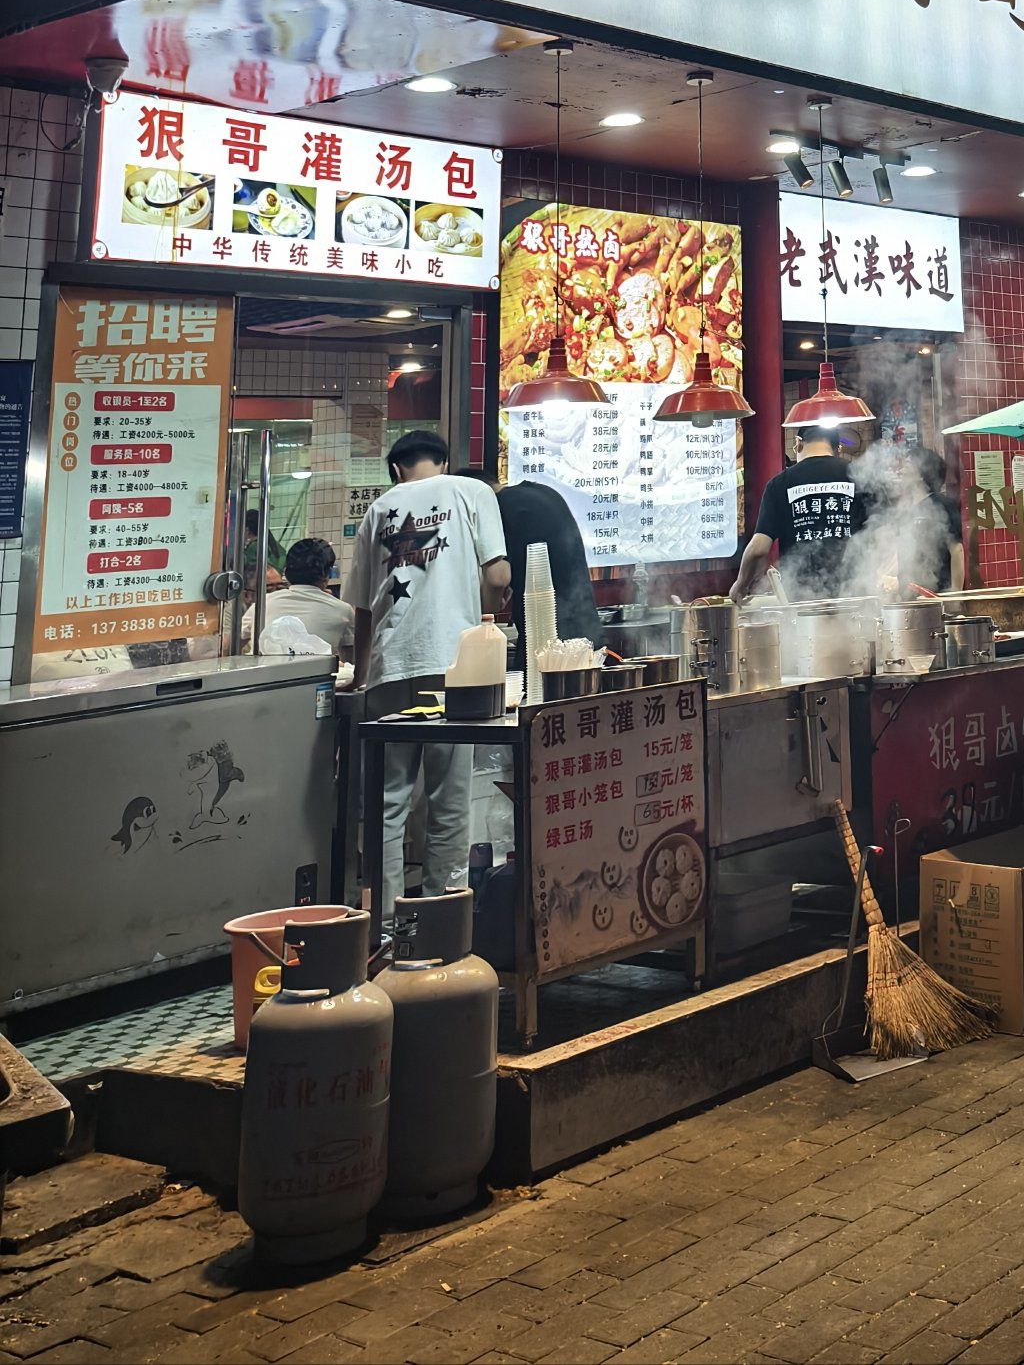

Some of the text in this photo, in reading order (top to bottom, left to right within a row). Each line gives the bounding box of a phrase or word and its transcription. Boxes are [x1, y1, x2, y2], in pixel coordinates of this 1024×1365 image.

[137, 105, 478, 201] 狠哥灌汤包
[172, 234, 445, 279] 中华传统美味小吃
[519, 219, 622, 264] 狠哥热卤
[779, 227, 955, 302] 老武漢味道
[76, 299, 218, 348] 招聘
[74, 351, 209, 385] 等你来
[102, 395, 168, 407] 收银员-1至2名
[103, 448, 161, 460] 服务员-10名
[66, 587, 184, 610] 以上工作均包吃包住
[91, 622, 116, 635] 137
[120, 618, 155, 631] 3838
[158, 613, 190, 628] 6201
[541, 688, 698, 748] 狠哥灌汤包
[544, 732, 693, 783] 狠哥灌汤包 15元/笼
[544, 780, 624, 816] 狠哥小笼包
[545, 819, 594, 850] 绿豆汤
